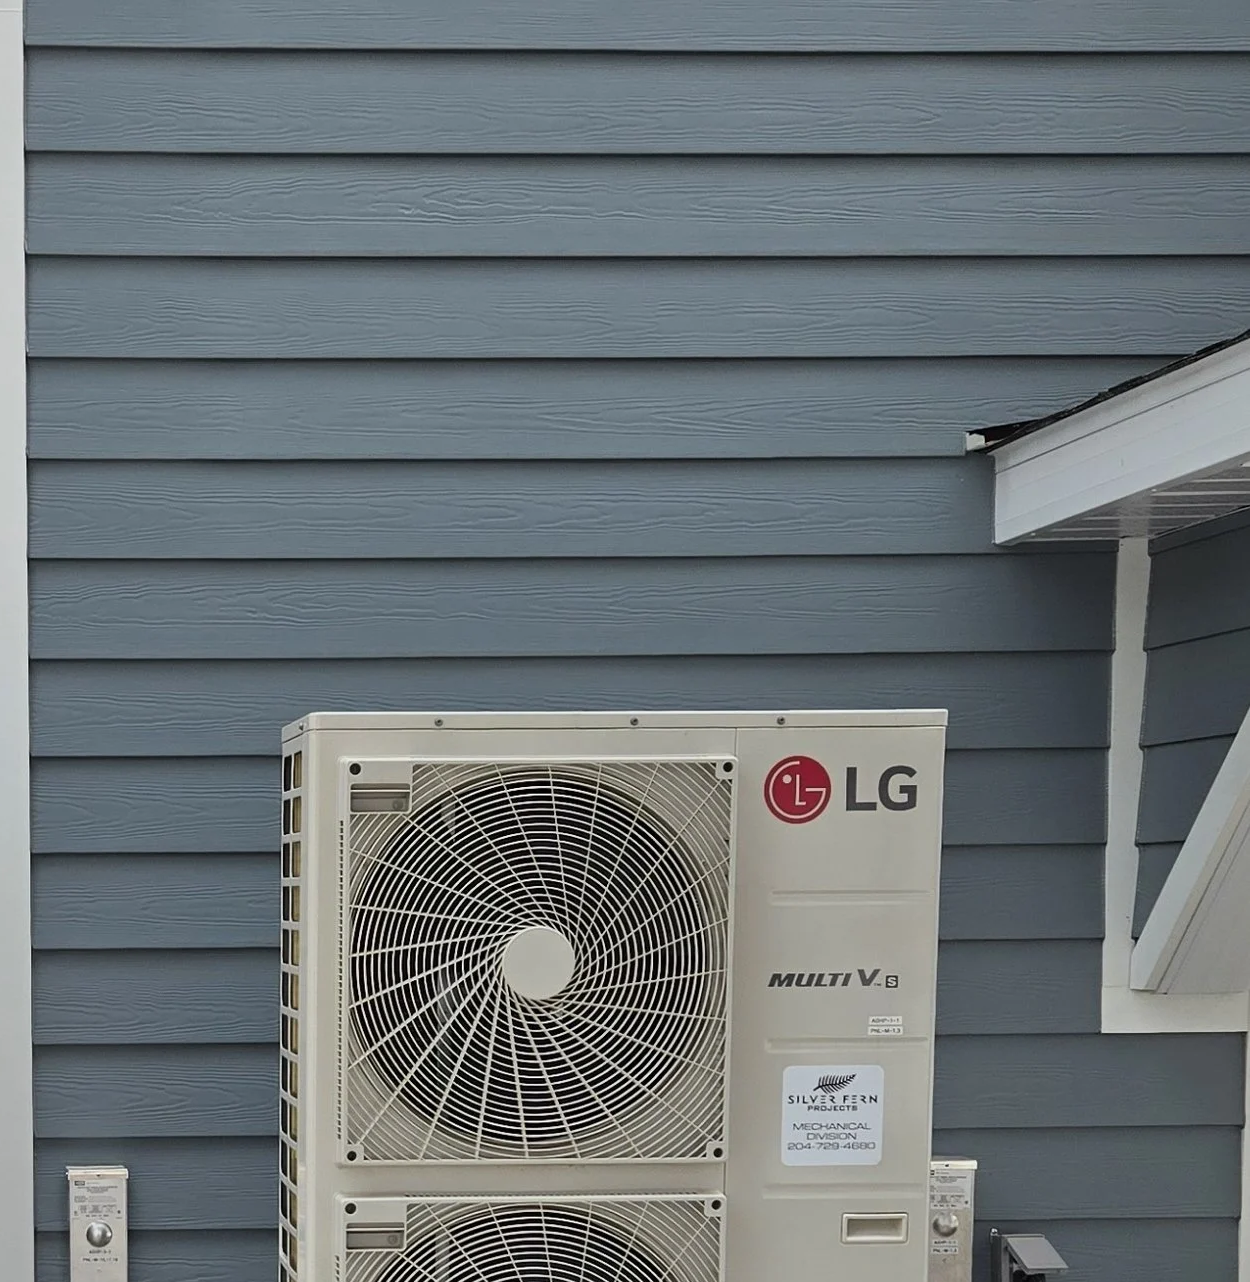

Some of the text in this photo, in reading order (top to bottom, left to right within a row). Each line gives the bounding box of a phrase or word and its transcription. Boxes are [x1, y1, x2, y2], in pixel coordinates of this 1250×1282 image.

[845, 765, 918, 811] LG
[767, 972, 853, 987] MULTI
[787, 1094, 878, 1104] SILVER FERN
[792, 1122, 872, 1130] MECHANICAL
[806, 1132, 857, 1140] DIVISION
[787, 1141, 876, 1150] 204-729-4680
